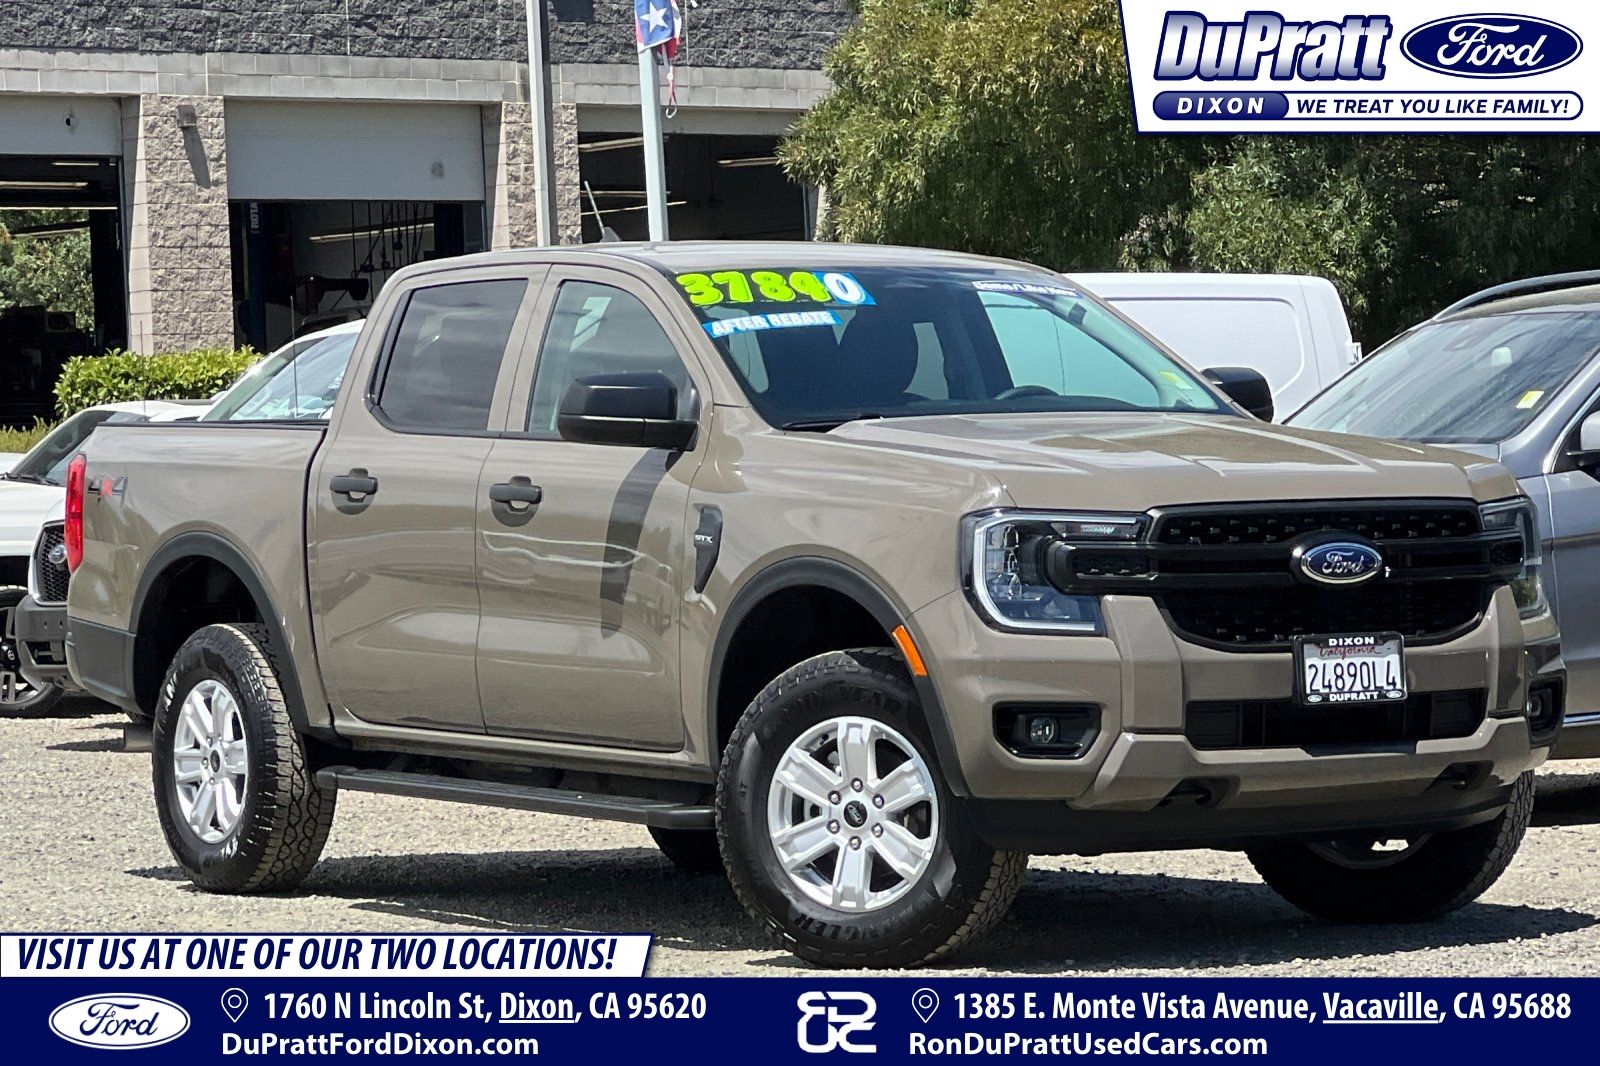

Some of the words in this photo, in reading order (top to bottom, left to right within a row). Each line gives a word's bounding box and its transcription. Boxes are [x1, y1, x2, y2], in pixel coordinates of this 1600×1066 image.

[711, 315, 768, 336] AFTER
[767, 311, 836, 329] REBATE
[1322, 551, 1364, 573] Ford
[1329, 637, 1375, 646] DIXON
[1309, 661, 1397, 693] 24890L4
[1330, 691, 1379, 702] DUPRATT
